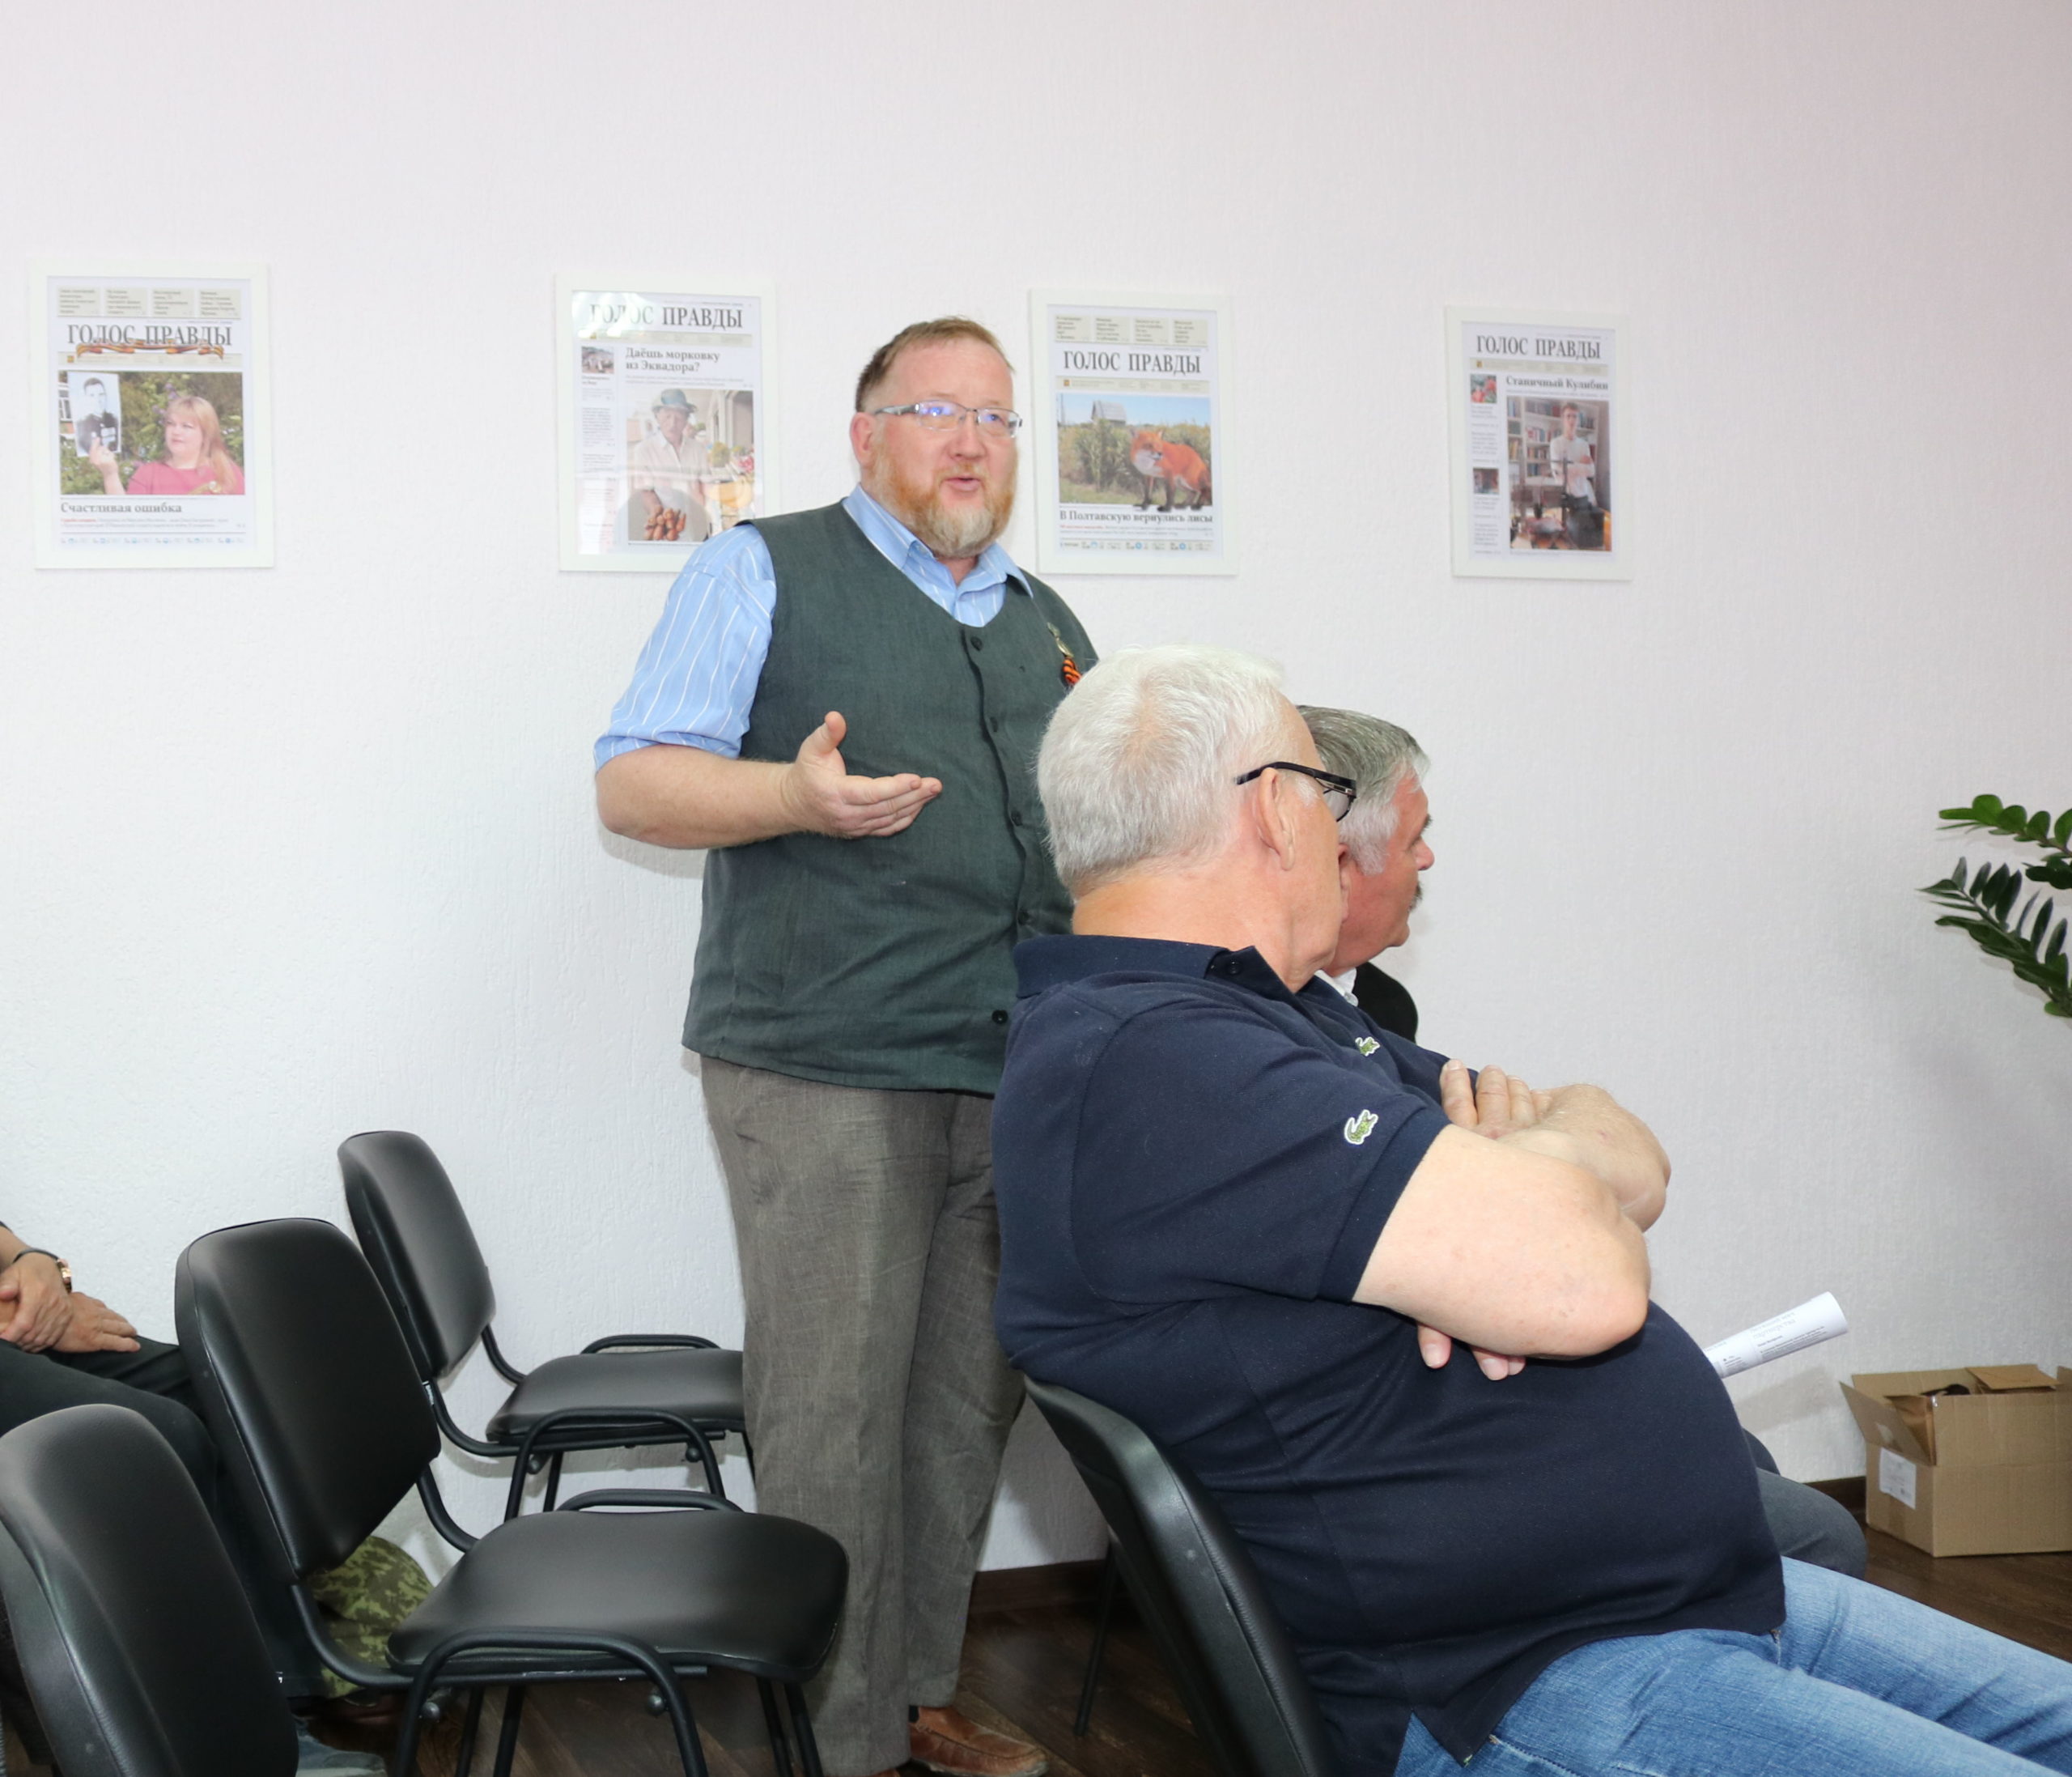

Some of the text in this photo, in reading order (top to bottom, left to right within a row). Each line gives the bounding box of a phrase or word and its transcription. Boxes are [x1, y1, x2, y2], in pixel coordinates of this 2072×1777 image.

[663, 306, 743, 330] ПРАВДЫ
[67, 324, 232, 346] ГОЛОС ПРАВДЫ
[626, 346, 720, 363] Даёшь морковку
[1476, 334, 1601, 361] ГОЛОС ПРАВДЫ
[626, 361, 700, 373] из Эквадора?
[1064, 351, 1201, 376] ГОЛОС ПРАВДЫ
[1506, 375, 1609, 391] Станичный Кулибин
[61, 501, 182, 513] Счастливая ошибка
[1059, 510, 1213, 525] В Полтавскую вернулись лисы
